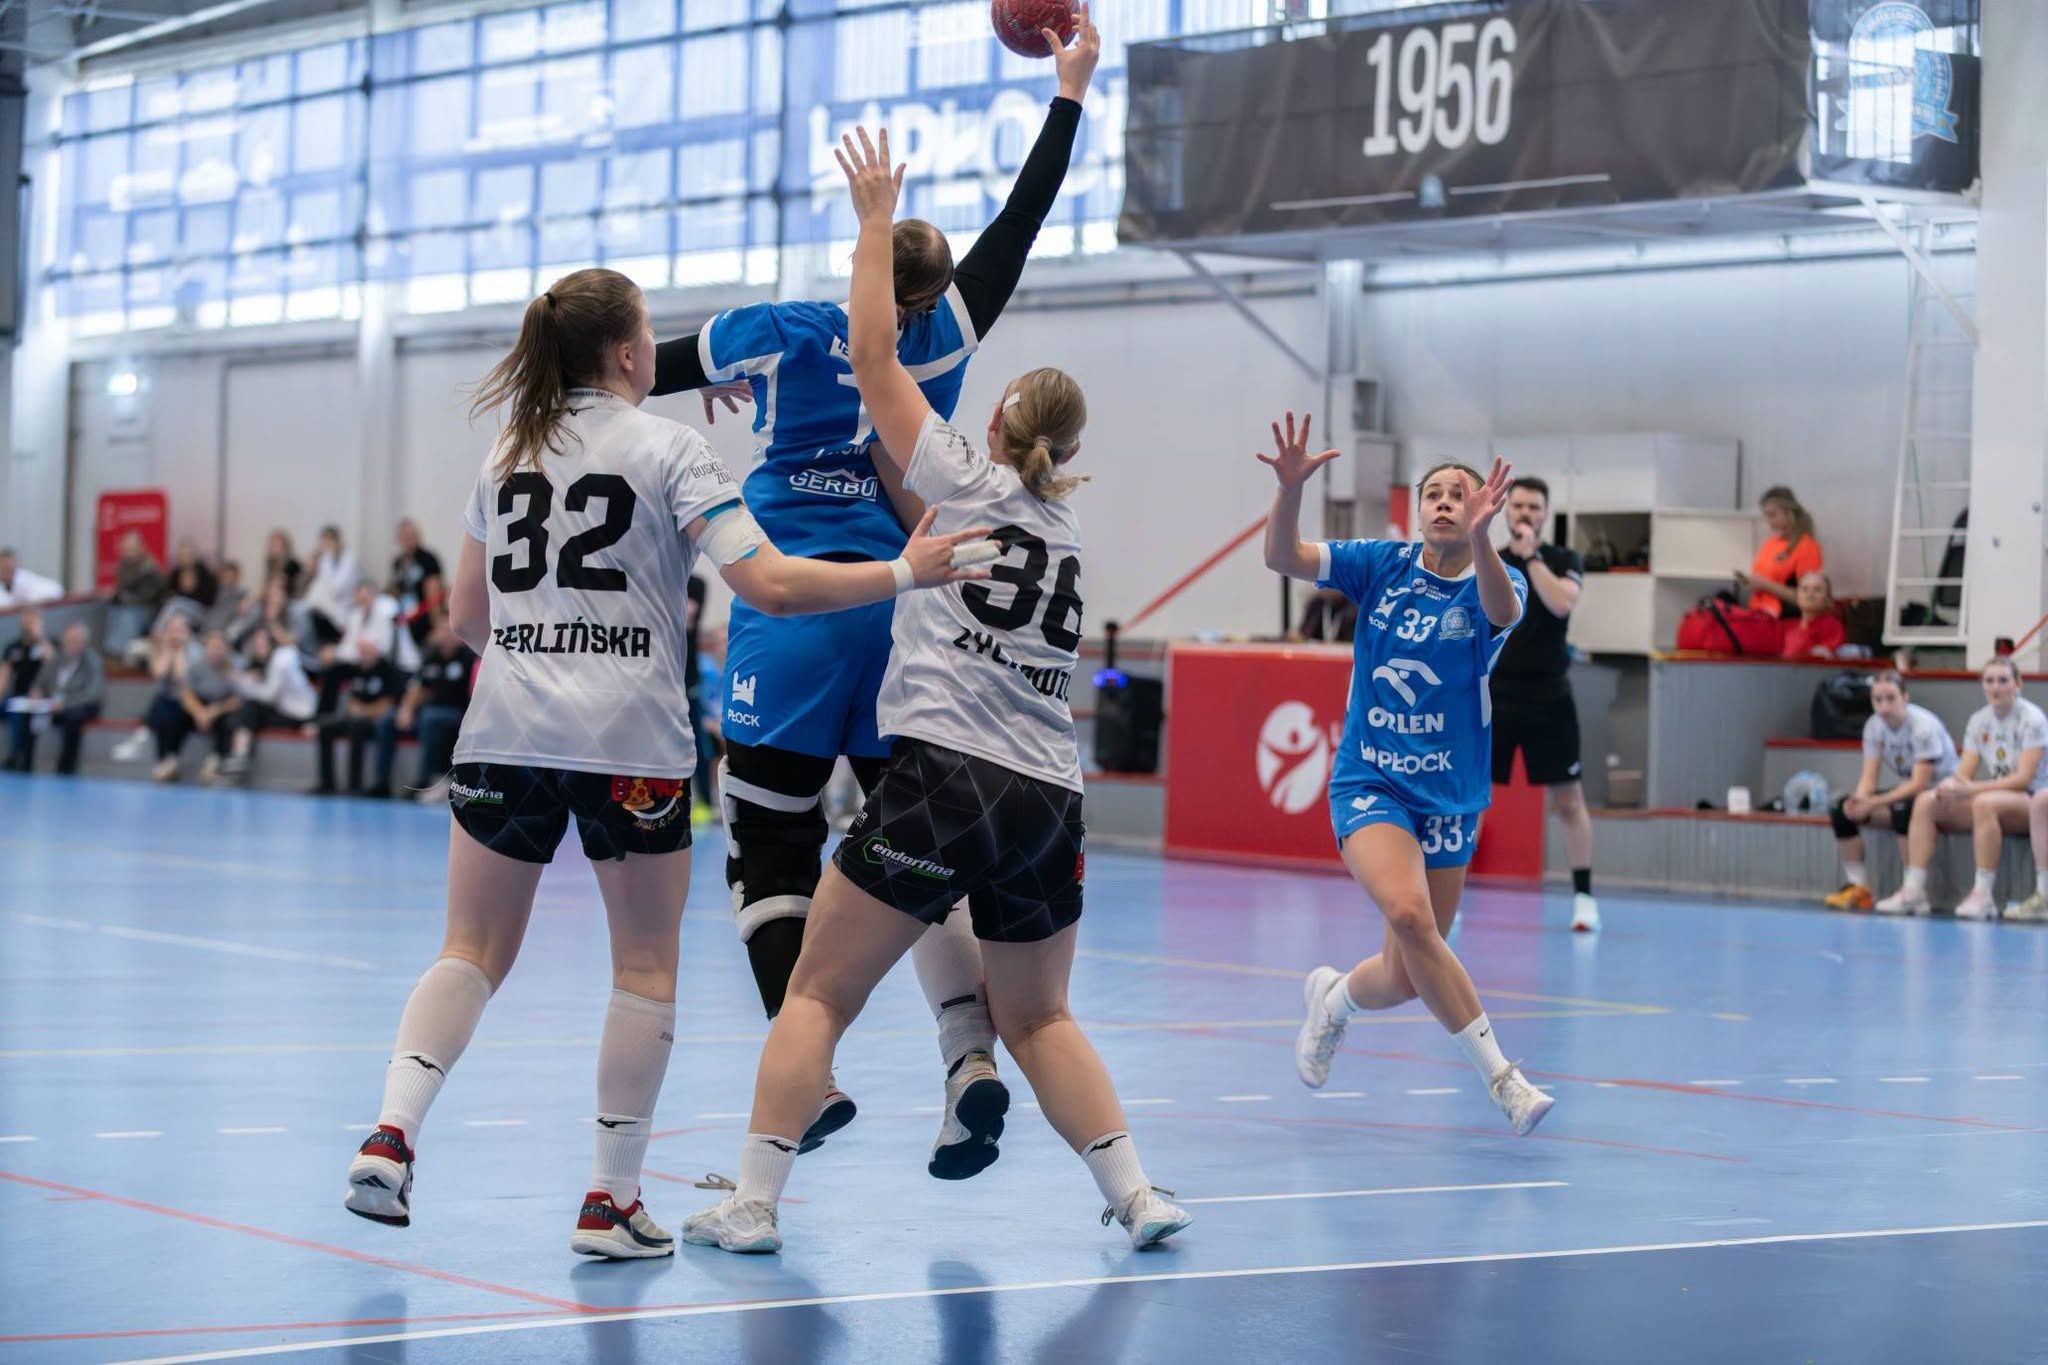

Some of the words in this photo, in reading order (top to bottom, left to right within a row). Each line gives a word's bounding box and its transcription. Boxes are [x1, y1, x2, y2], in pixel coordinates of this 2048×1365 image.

[1363, 17, 1515, 157] 1956
[789, 471, 879, 499] GERBU
[492, 471, 637, 594] 32
[1396, 607, 1438, 643] 33
[727, 707, 761, 728] PŁOCK
[1367, 706, 1445, 735] ORLEN
[1377, 750, 1454, 775] PŁOCK
[1421, 814, 1464, 856] 33
[871, 843, 956, 876] endorfina
